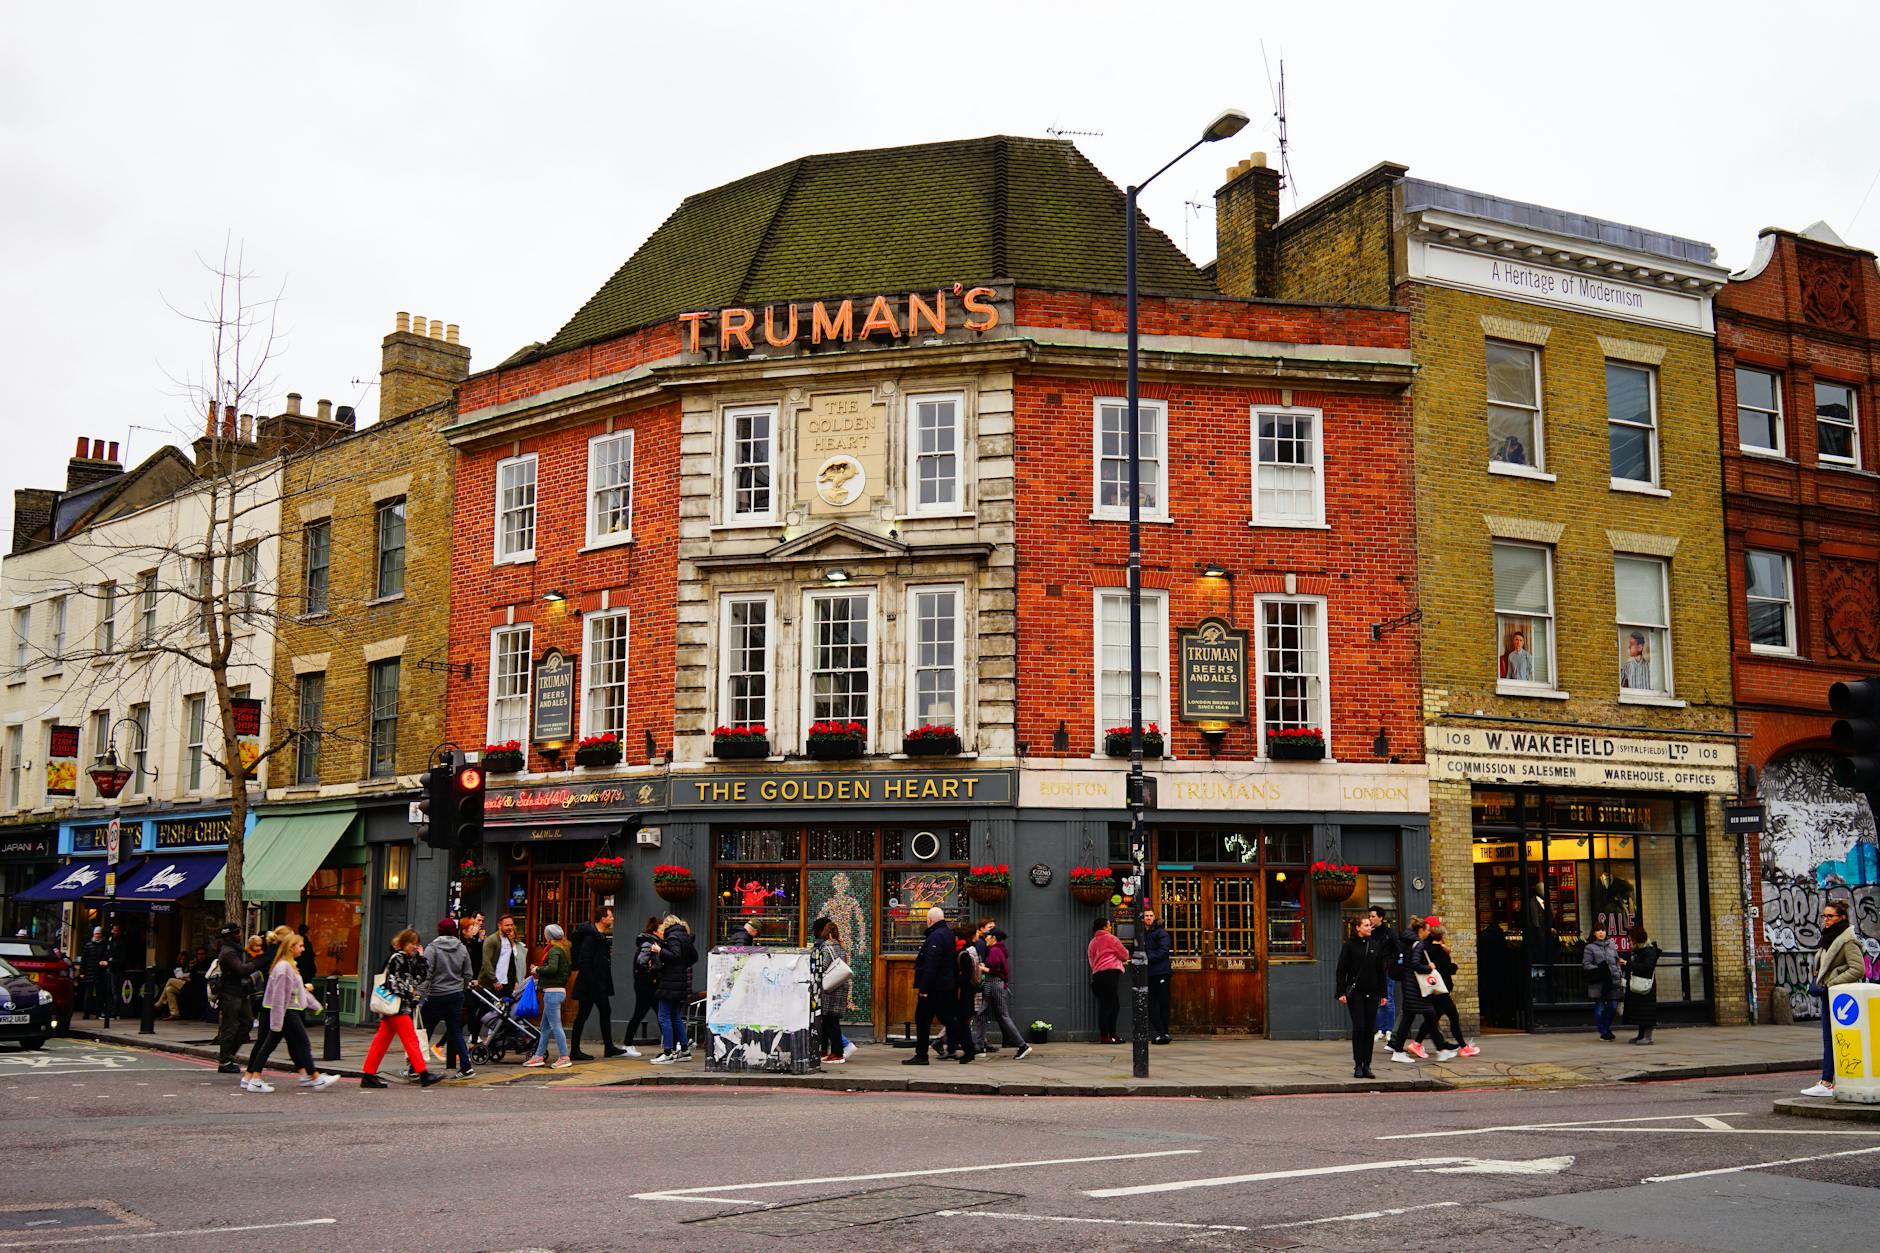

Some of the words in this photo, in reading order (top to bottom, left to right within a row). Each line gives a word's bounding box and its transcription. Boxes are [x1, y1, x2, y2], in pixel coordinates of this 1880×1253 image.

[1491, 261, 1500, 281] A
[1504, 264, 1555, 294] Heritage
[1562, 276, 1575, 294] of
[1579, 279, 1643, 308] Modernism
[679, 283, 1000, 354] TRUMAN'S
[825, 401, 859, 415] THE
[808, 416, 876, 433] GOLDEN
[813, 435, 870, 451] HEART
[1187, 646, 1239, 662] TRUMAN
[1192, 664, 1234, 674] BEERS
[538, 673, 570, 689] TRUMAN
[1189, 674, 1210, 682] AND
[1211, 674, 1238, 683] ALES
[539, 700, 552, 708] AND
[552, 698, 568, 707] ALES
[542, 690, 565, 700] BEERS
[1446, 733, 1471, 745] 108
[1698, 748, 1718, 759] 108
[1447, 761, 1516, 775] COMMISSION
[1521, 764, 1577, 778] SALESMEN
[1674, 773, 1716, 785] OFFICES
[694, 782, 747, 801] THE
[759, 779, 871, 800] GOLDEN
[884, 778, 979, 799] HEART
[1040, 781, 1108, 796] BURTON
[1173, 781, 1281, 801] TRUMAN'S
[1343, 786, 1409, 801] LONDON
[1570, 805, 1593, 822] BEN
[1598, 806, 1651, 825] SHERMAN
[160, 823, 186, 845] FISH
[194, 819, 231, 843] CHIPS
